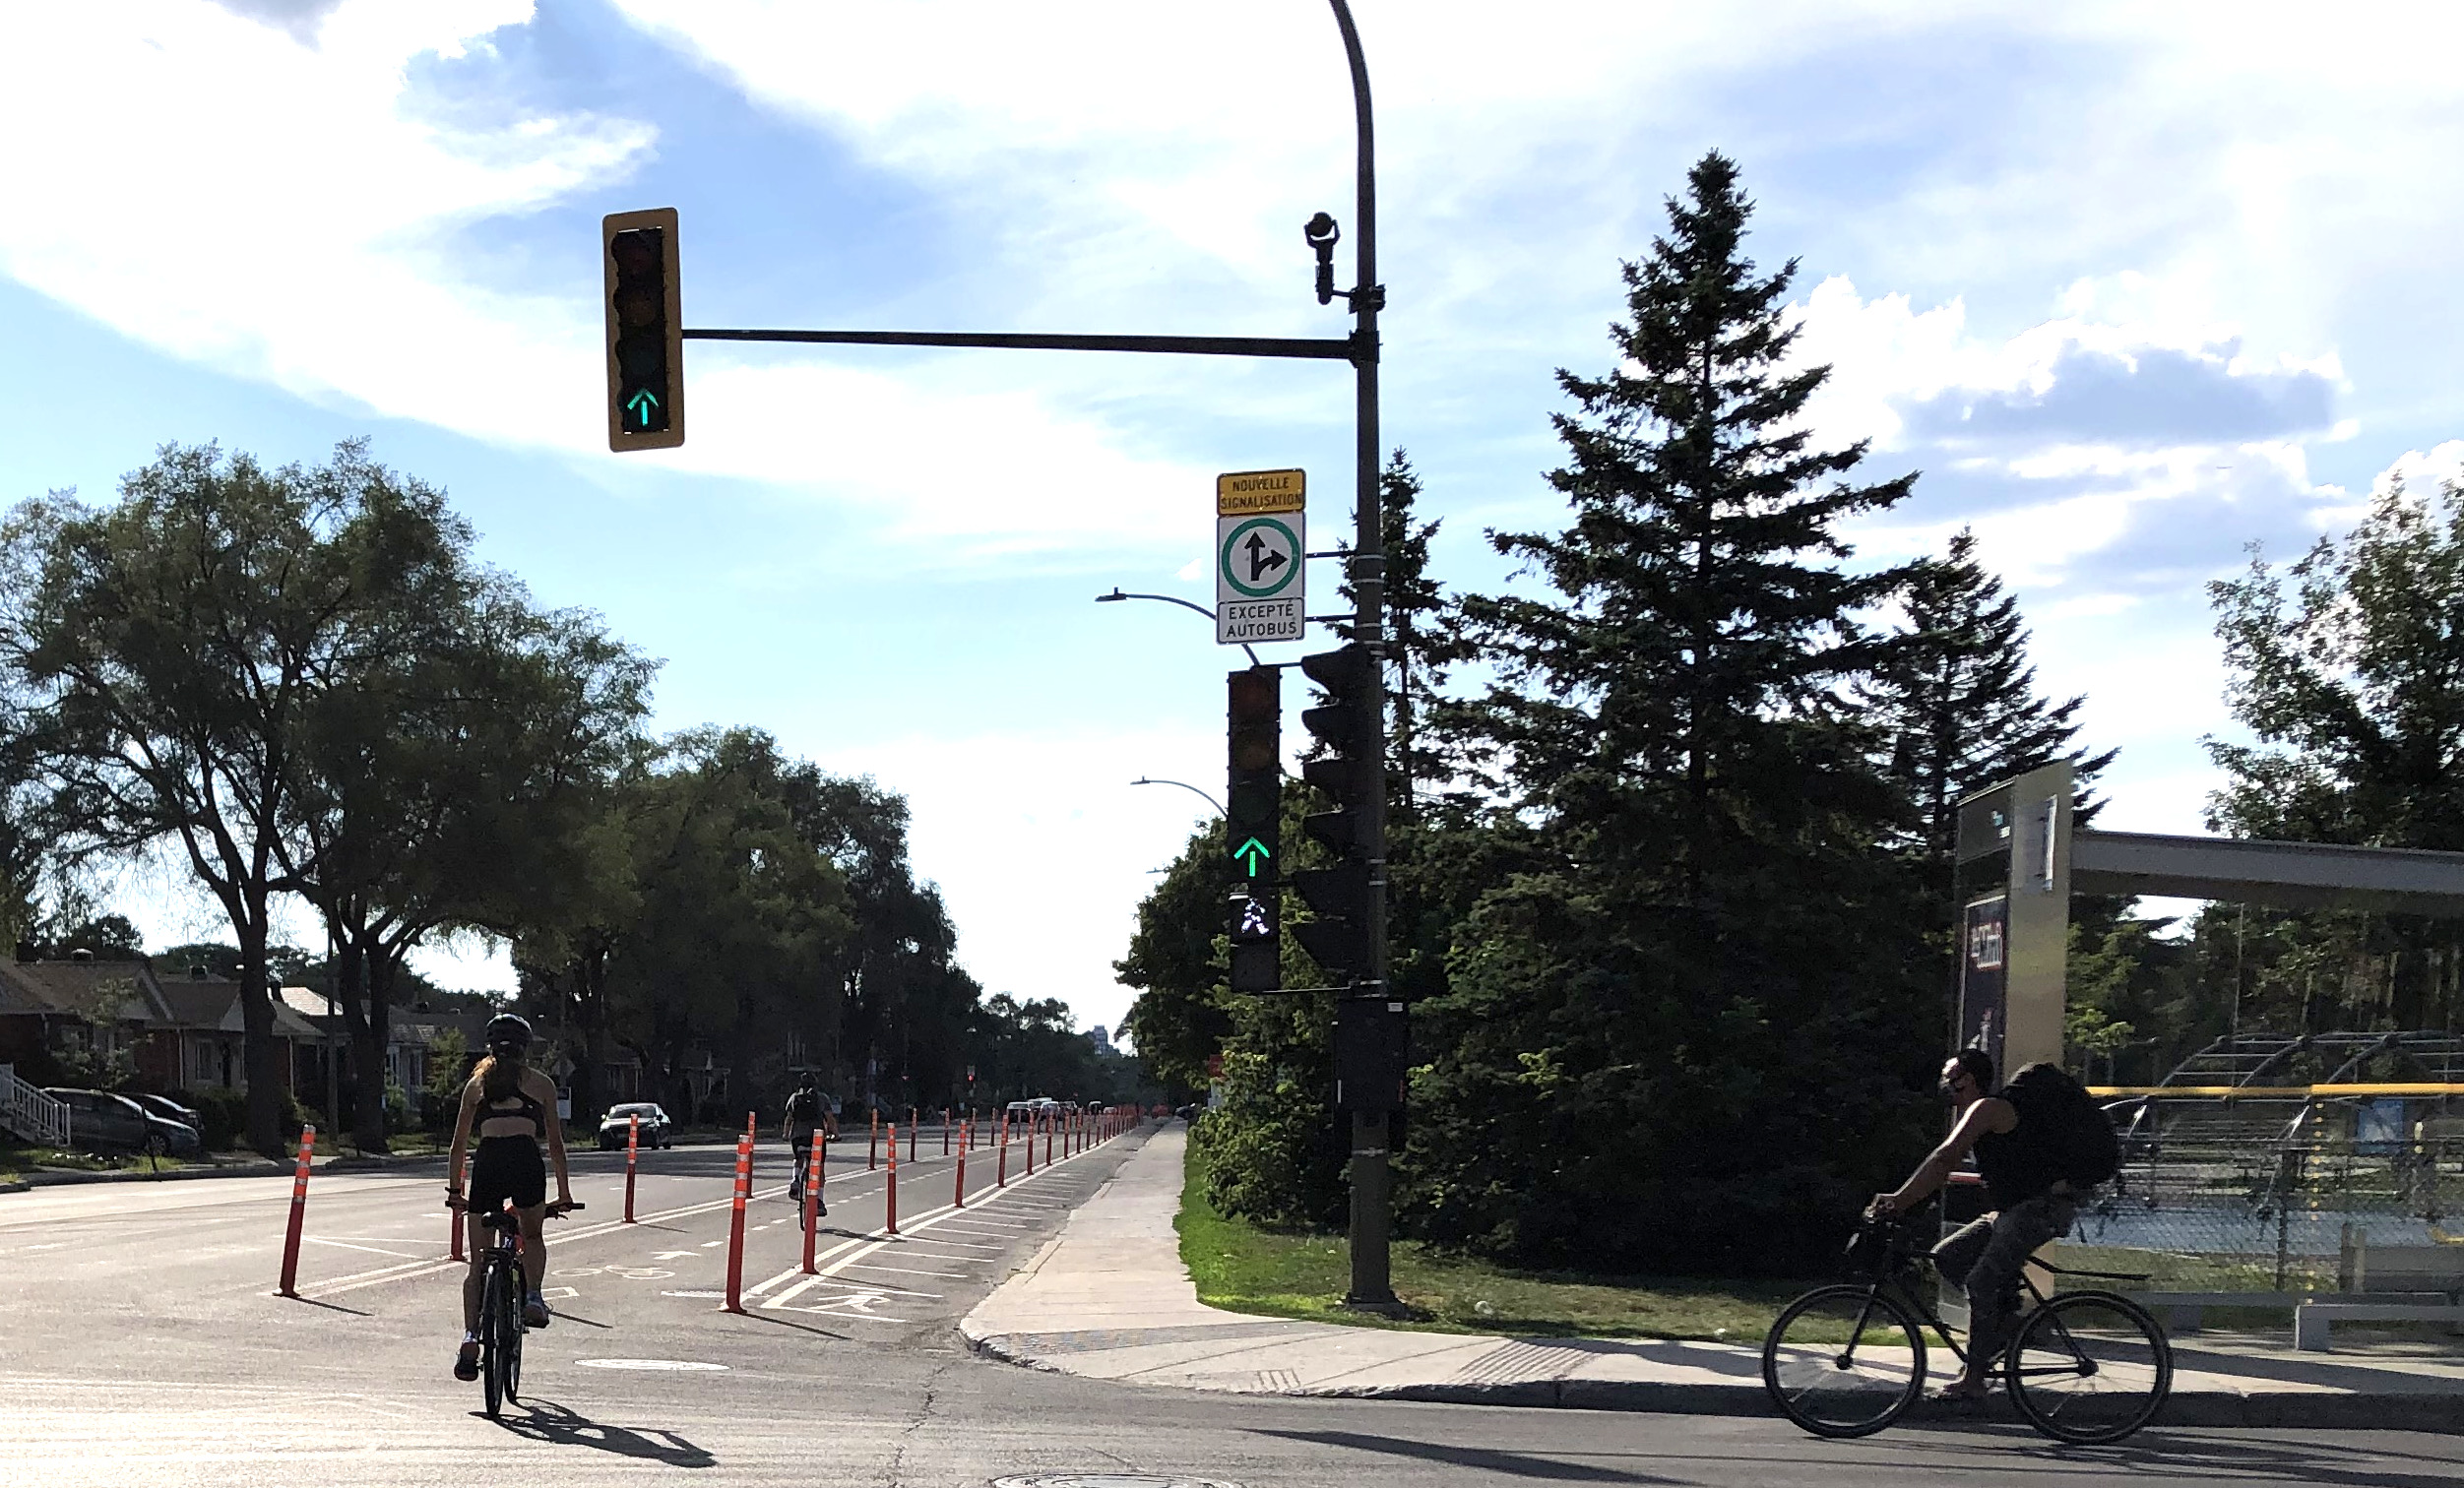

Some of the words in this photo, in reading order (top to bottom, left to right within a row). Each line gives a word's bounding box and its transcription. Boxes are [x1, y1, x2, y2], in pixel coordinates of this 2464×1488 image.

[1232, 477, 1289, 492] NOUVELLE
[1221, 493, 1301, 510] SIGNALISATION
[1229, 600, 1294, 619] EXCEPTÉ
[1226, 622, 1296, 638] AUTOBUS
